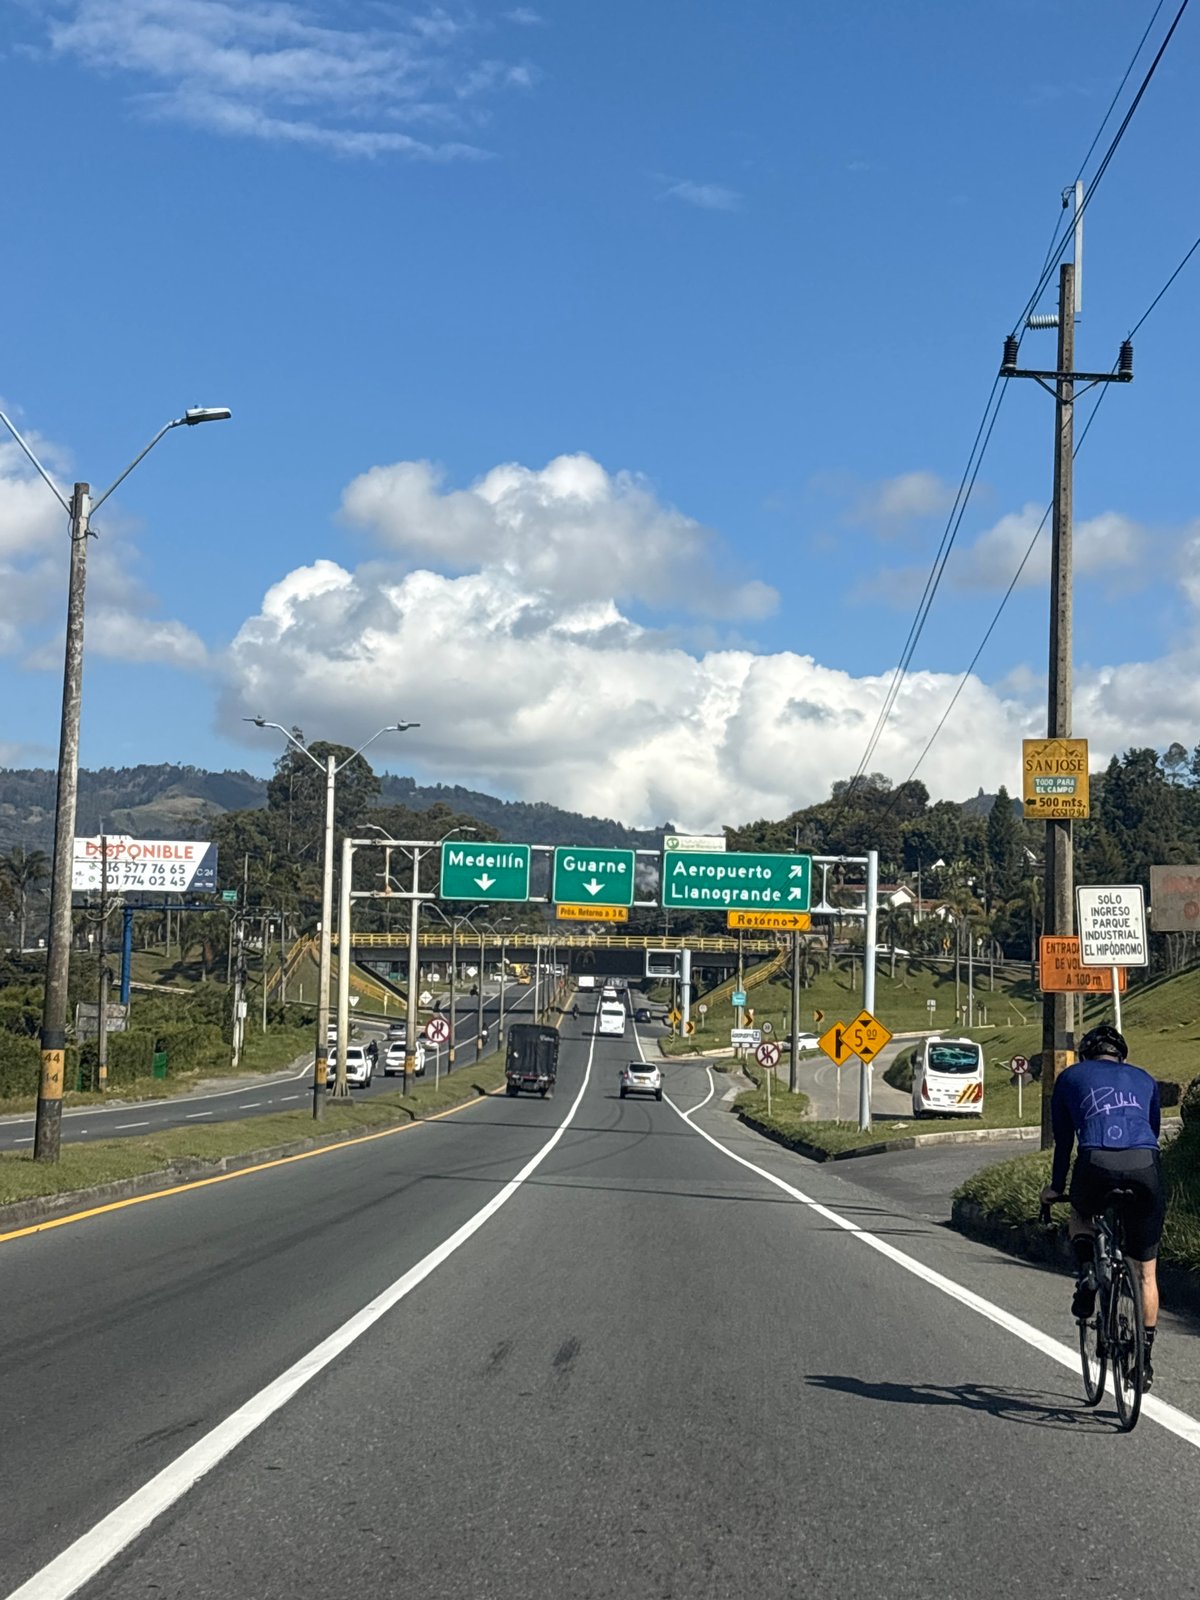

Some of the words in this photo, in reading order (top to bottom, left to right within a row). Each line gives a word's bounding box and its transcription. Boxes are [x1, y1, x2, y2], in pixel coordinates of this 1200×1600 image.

[1026, 760, 1053, 772] SAN
[1047, 786, 1074, 794] CAMPO
[1039, 798, 1060, 808] 500
[1061, 798, 1086, 809] mts.
[86, 842, 194, 860] DSPONIBLE
[449, 850, 524, 869] Medellín
[563, 856, 626, 874] Guarne
[100, 862, 120, 873] 16
[125, 863, 147, 874] 577
[151, 864, 166, 875] 76
[169, 864, 186, 875] 65
[672, 861, 772, 880] Aeropuerto
[98, 874, 119, 885] 01
[123, 875, 145, 886] 774
[148, 876, 166, 886] 02
[169, 876, 187, 887] 45
[671, 883, 782, 904] Llanogrande
[1090, 906, 1130, 917] INGRESO
[737, 915, 788, 927] Retorno
[1092, 918, 1131, 929] PARQUE
[1085, 929, 1140, 941] INDUSTRIAL
[1084, 944, 1095, 956] EL
[1096, 941, 1143, 956] HIPÓDROMO
[1055, 958, 1065, 970] DE
[1065, 973, 1072, 985] A
[1075, 974, 1091, 985] 100
[855, 1028, 864, 1048] 5
[44, 1052, 60, 1064] 44
